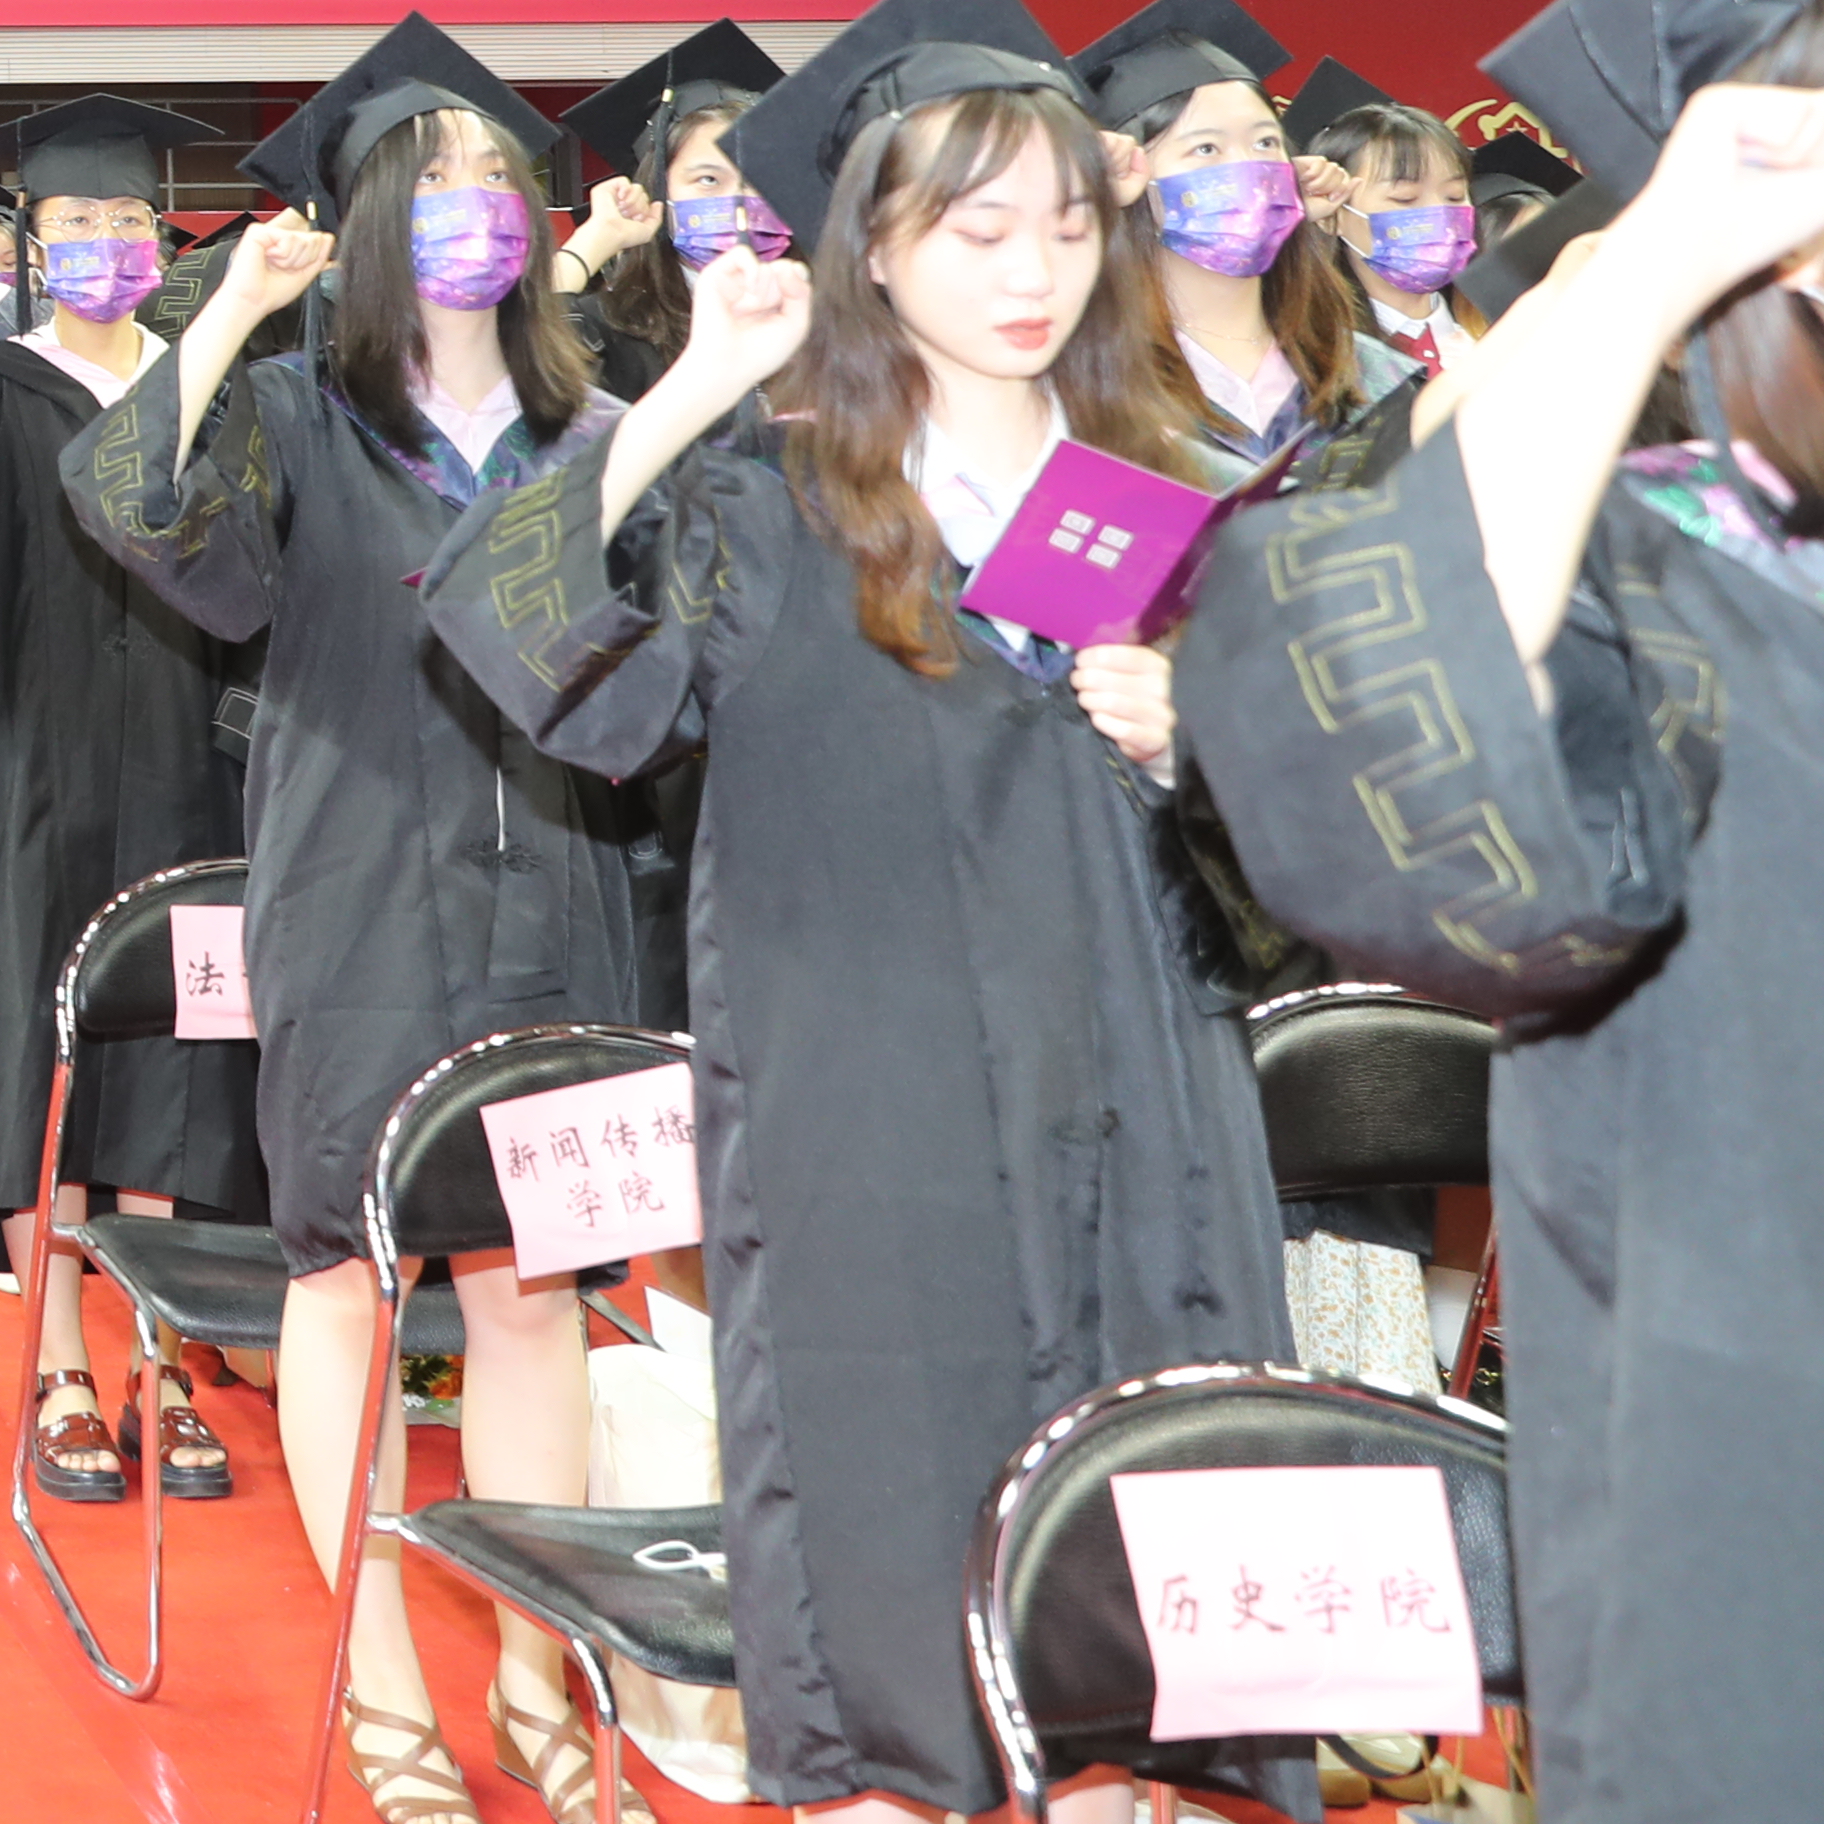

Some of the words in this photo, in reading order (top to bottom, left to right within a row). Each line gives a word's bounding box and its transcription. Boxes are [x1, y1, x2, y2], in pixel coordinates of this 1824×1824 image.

[506, 1104, 696, 1182] 新闻传播
[565, 1170, 666, 1228] 学院
[1156, 1564, 1452, 1635] 历史学院
